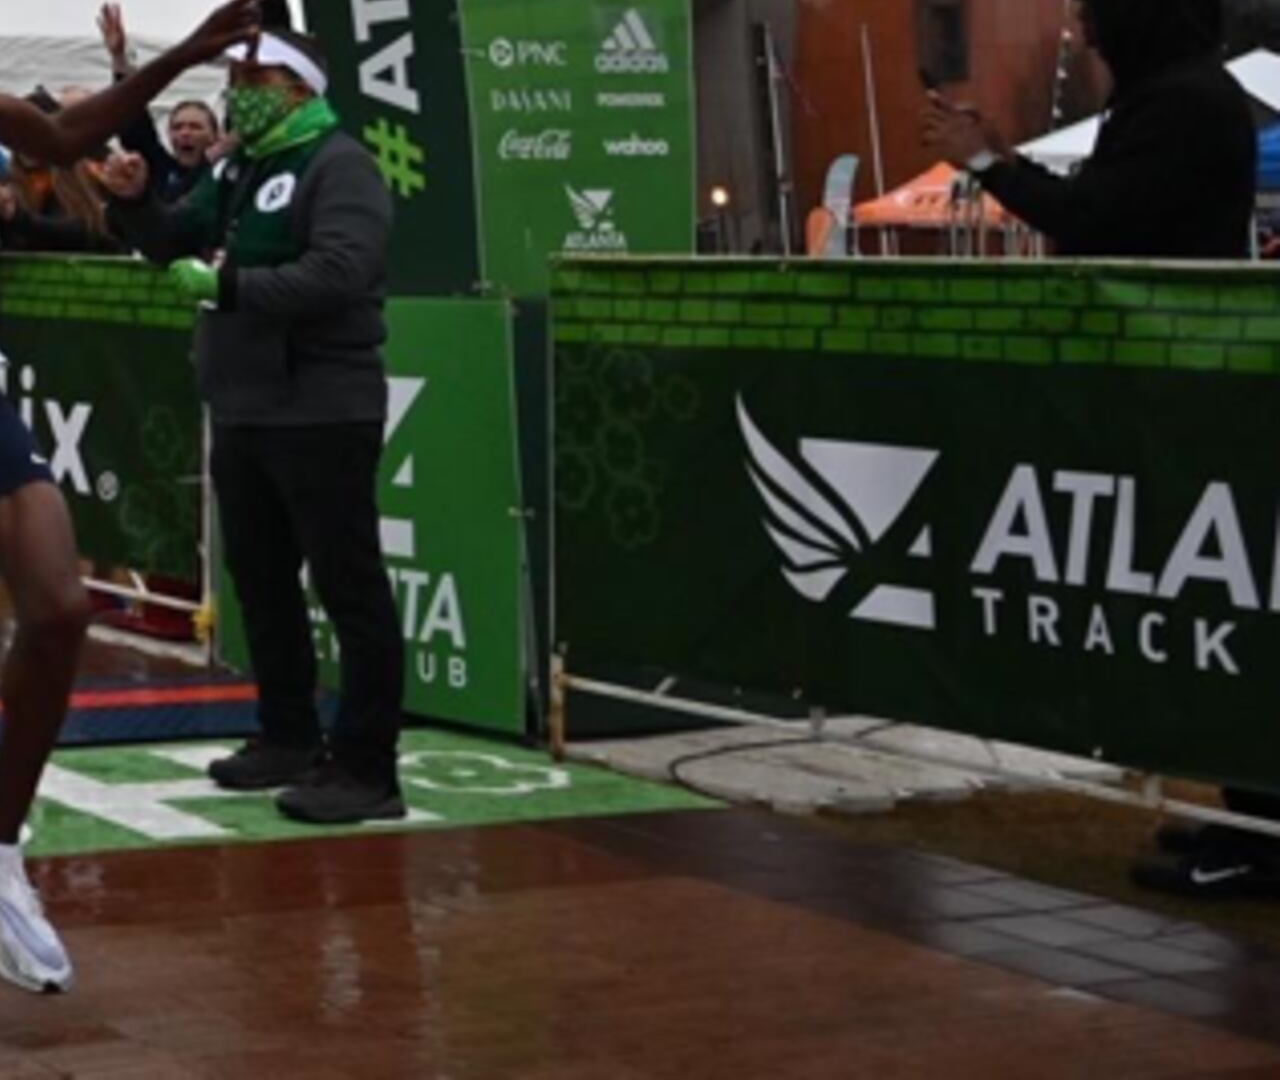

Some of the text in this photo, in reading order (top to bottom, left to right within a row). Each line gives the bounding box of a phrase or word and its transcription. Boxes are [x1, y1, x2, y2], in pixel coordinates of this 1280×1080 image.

[516, 39, 569, 66] PNC
[593, 48, 669, 73] adidas
[491, 86, 572, 114] DASANI
[602, 131, 670, 157] wahoo
[561, 231, 628, 251] ATLANTA
[967, 461, 1280, 614] ATLA
[971, 586, 1241, 675] TRACK
